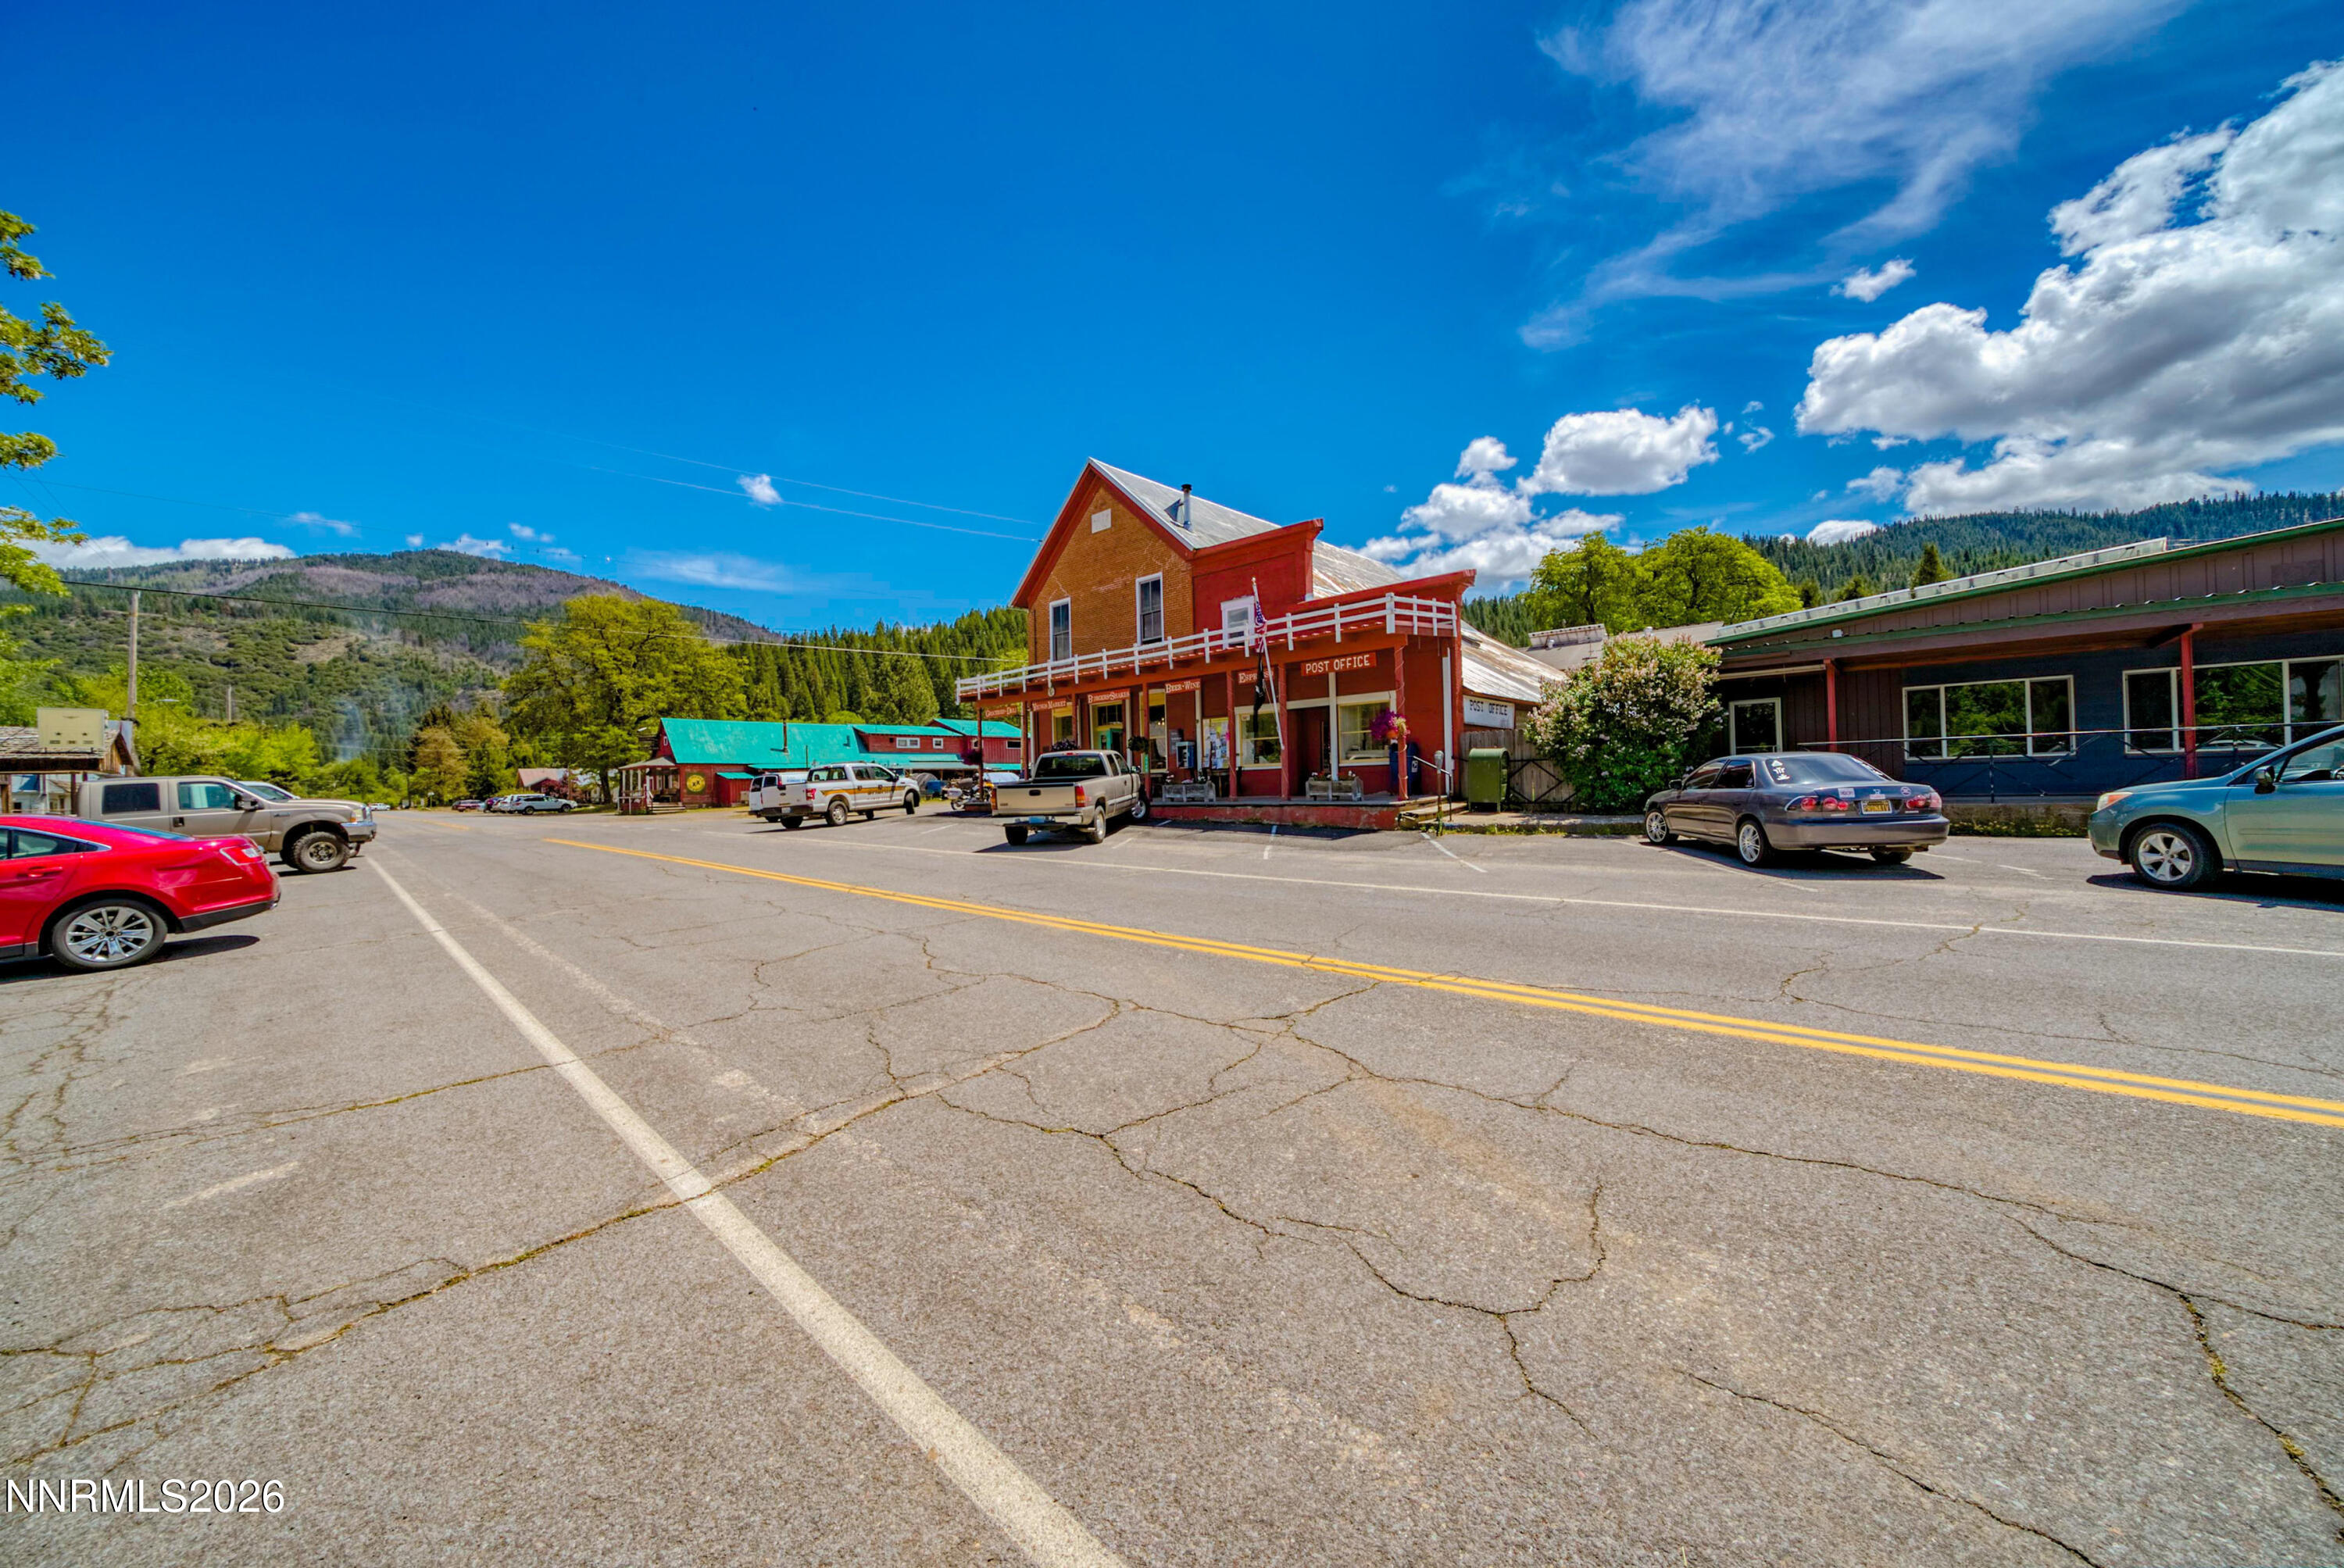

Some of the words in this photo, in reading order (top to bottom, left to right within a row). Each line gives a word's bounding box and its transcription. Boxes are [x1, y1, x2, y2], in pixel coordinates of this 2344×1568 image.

[1306, 660, 1330, 673] POST
[1333, 655, 1370, 670] OFFICE
[1470, 699, 1484, 712] POST
[1488, 702, 1508, 716] OFFICE
